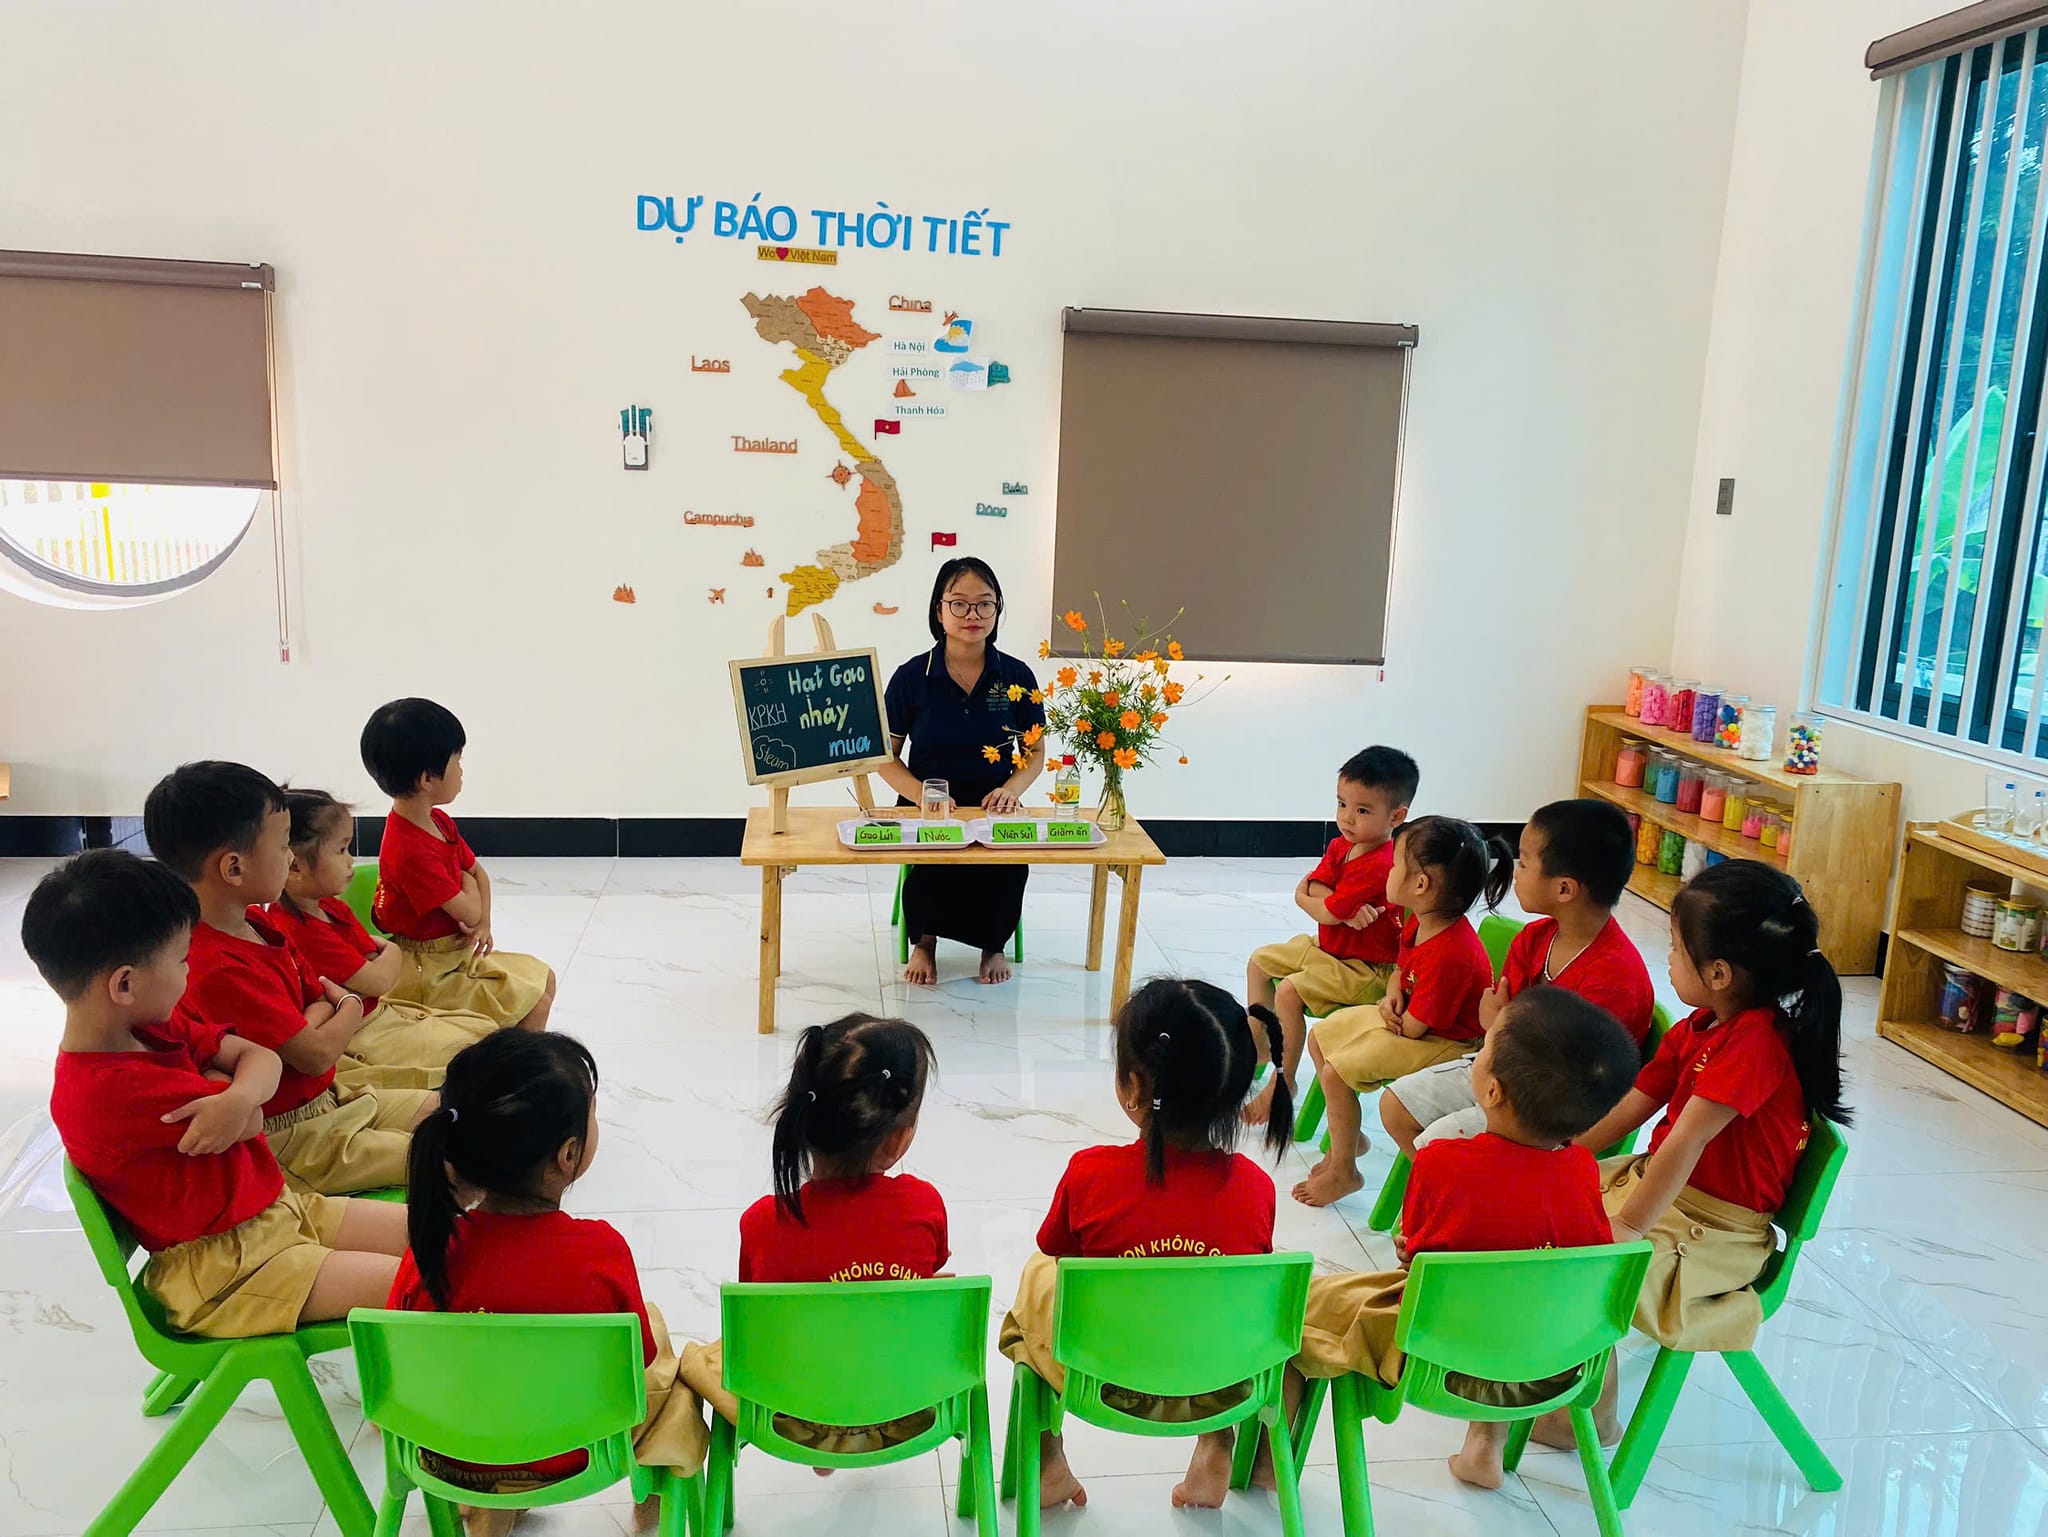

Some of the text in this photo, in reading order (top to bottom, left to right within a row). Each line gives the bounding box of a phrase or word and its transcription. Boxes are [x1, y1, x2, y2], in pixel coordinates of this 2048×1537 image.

[637, 192, 1011, 257] DỰ BÁO THỜI TIẾT
[812, 251, 836, 263] Nam
[888, 295, 932, 312] China
[894, 341, 925, 352] Hà Nội
[691, 355, 730, 373] Laos
[892, 367, 940, 378] Hải Phòng
[895, 405, 945, 415] Thanh Hóa
[731, 436, 798, 454] Thailand
[683, 510, 754, 528] Campuchia
[787, 664, 866, 698] Hạt Gạo
[749, 702, 788, 731] KPKH
[799, 696, 849, 732] nhảy
[828, 727, 871, 758] múa
[755, 743, 789, 770] Steam
[1150, 1234, 1206, 1255] KHÔNG
[829, 1261, 885, 1283] KHÔNG
